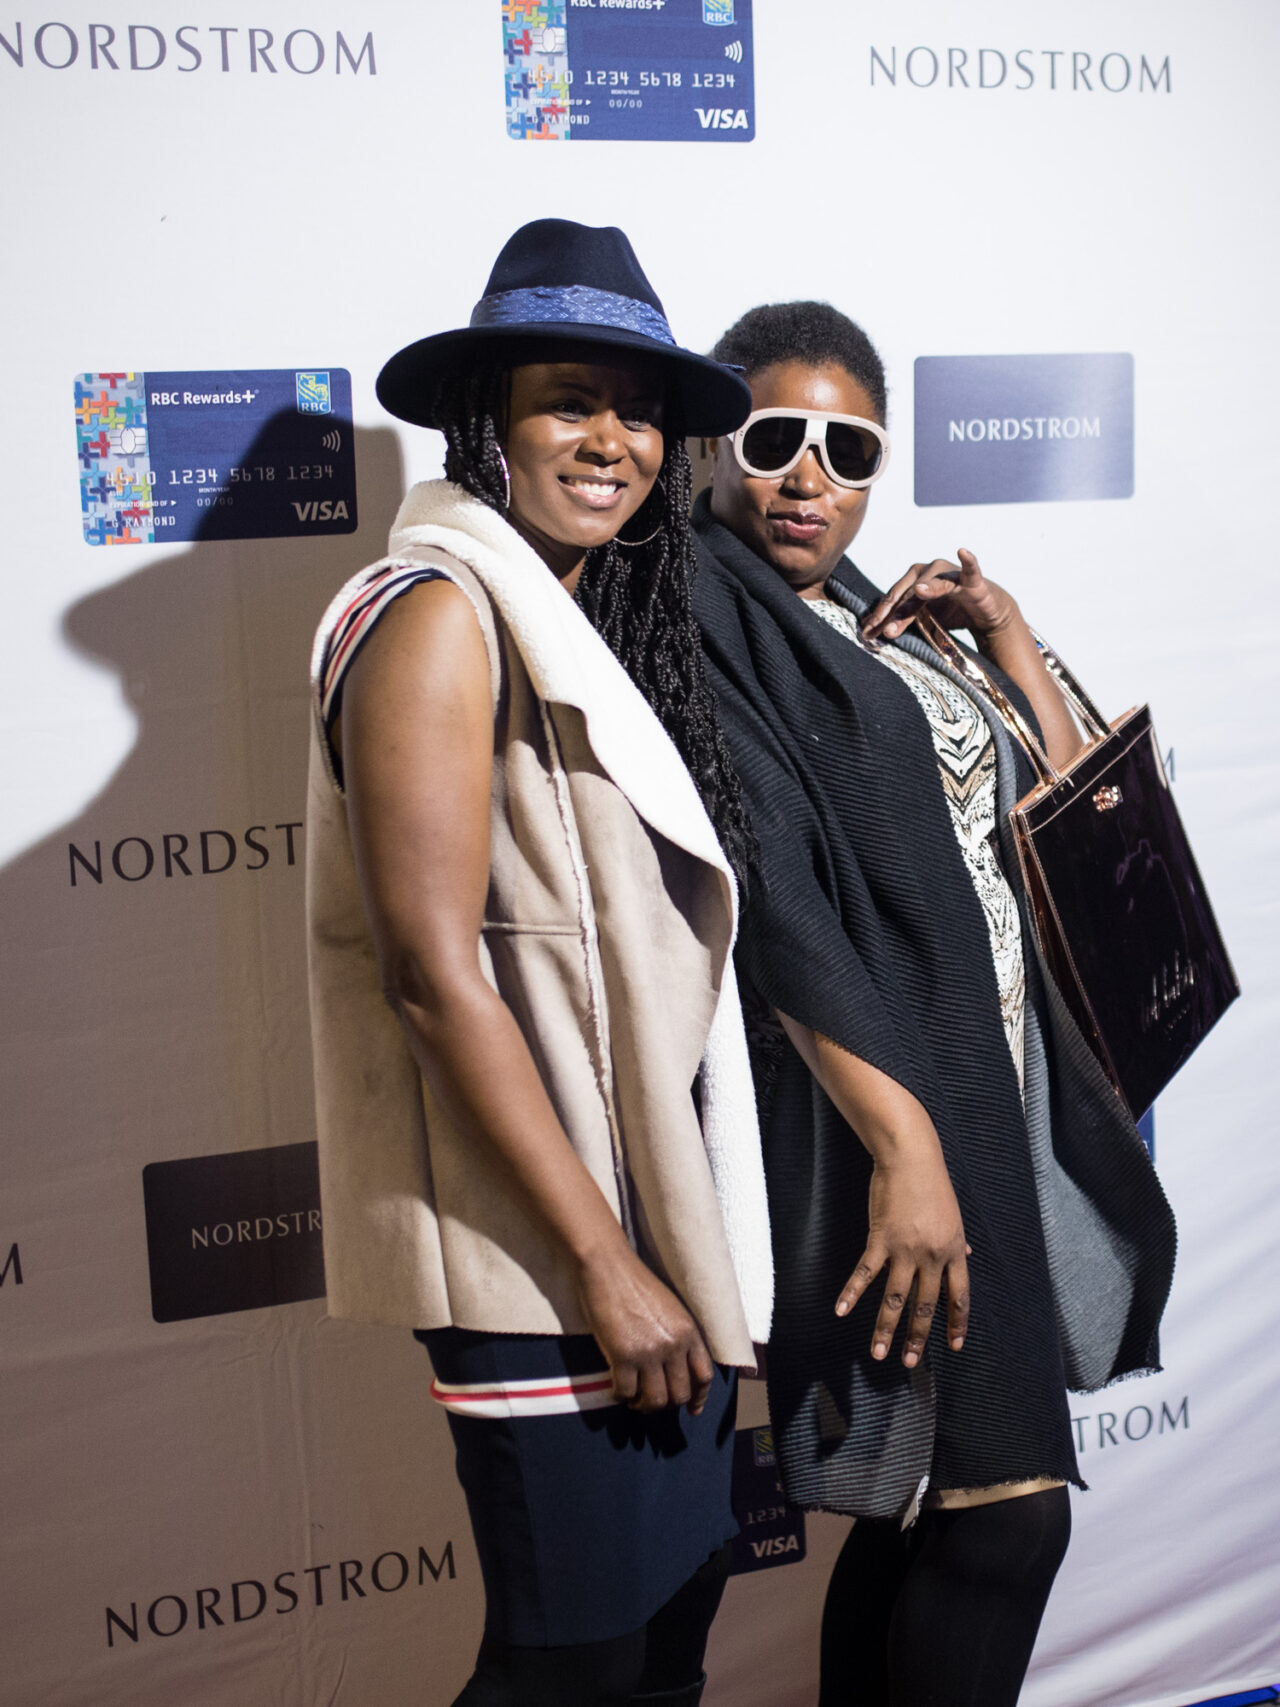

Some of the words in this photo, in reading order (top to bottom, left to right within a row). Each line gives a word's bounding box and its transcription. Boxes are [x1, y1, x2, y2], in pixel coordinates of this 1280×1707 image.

[705, 12, 731, 23] RBC
[0, 22, 377, 76] NORDSTROM
[584, 70, 630, 86] 1234
[640, 71, 682, 88] 5678
[692, 72, 736, 89] 1234
[870, 45, 1173, 94] NORDSTROM
[608, 98, 643, 109] 00/00
[693, 108, 749, 129] VISA
[151, 392, 180, 405] RBC
[301, 401, 328, 412] RBC
[949, 417, 1101, 443] NORDSTROM
[168, 467, 219, 486] 1234
[230, 467, 276, 483] 5678
[287, 464, 334, 480] 1234
[197, 497, 233, 507] 00/00
[291, 500, 350, 522] VISA
[68, 822, 304, 887] NORDST
[191, 1209, 322, 1249] NORDSTR
[746, 1506, 786, 1525] 1234
[750, 1534, 799, 1558] VISA
[106, 1541, 456, 1648] NORDSTROM
